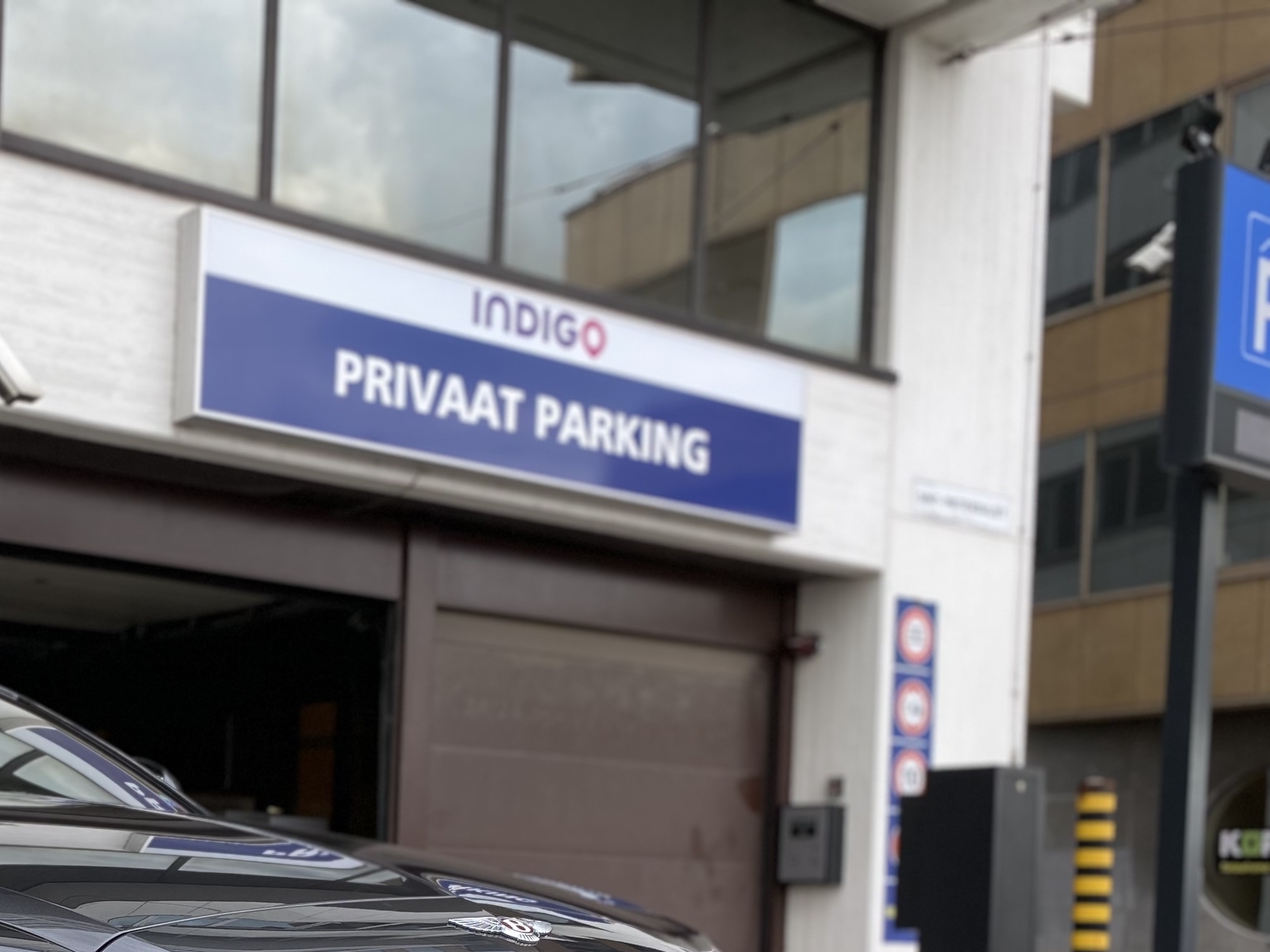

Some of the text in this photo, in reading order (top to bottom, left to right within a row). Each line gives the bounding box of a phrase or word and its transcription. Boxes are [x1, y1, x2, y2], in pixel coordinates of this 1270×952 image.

[472, 288, 608, 359] INDIGO
[334, 349, 711, 476] PRIVAAT PARKING
